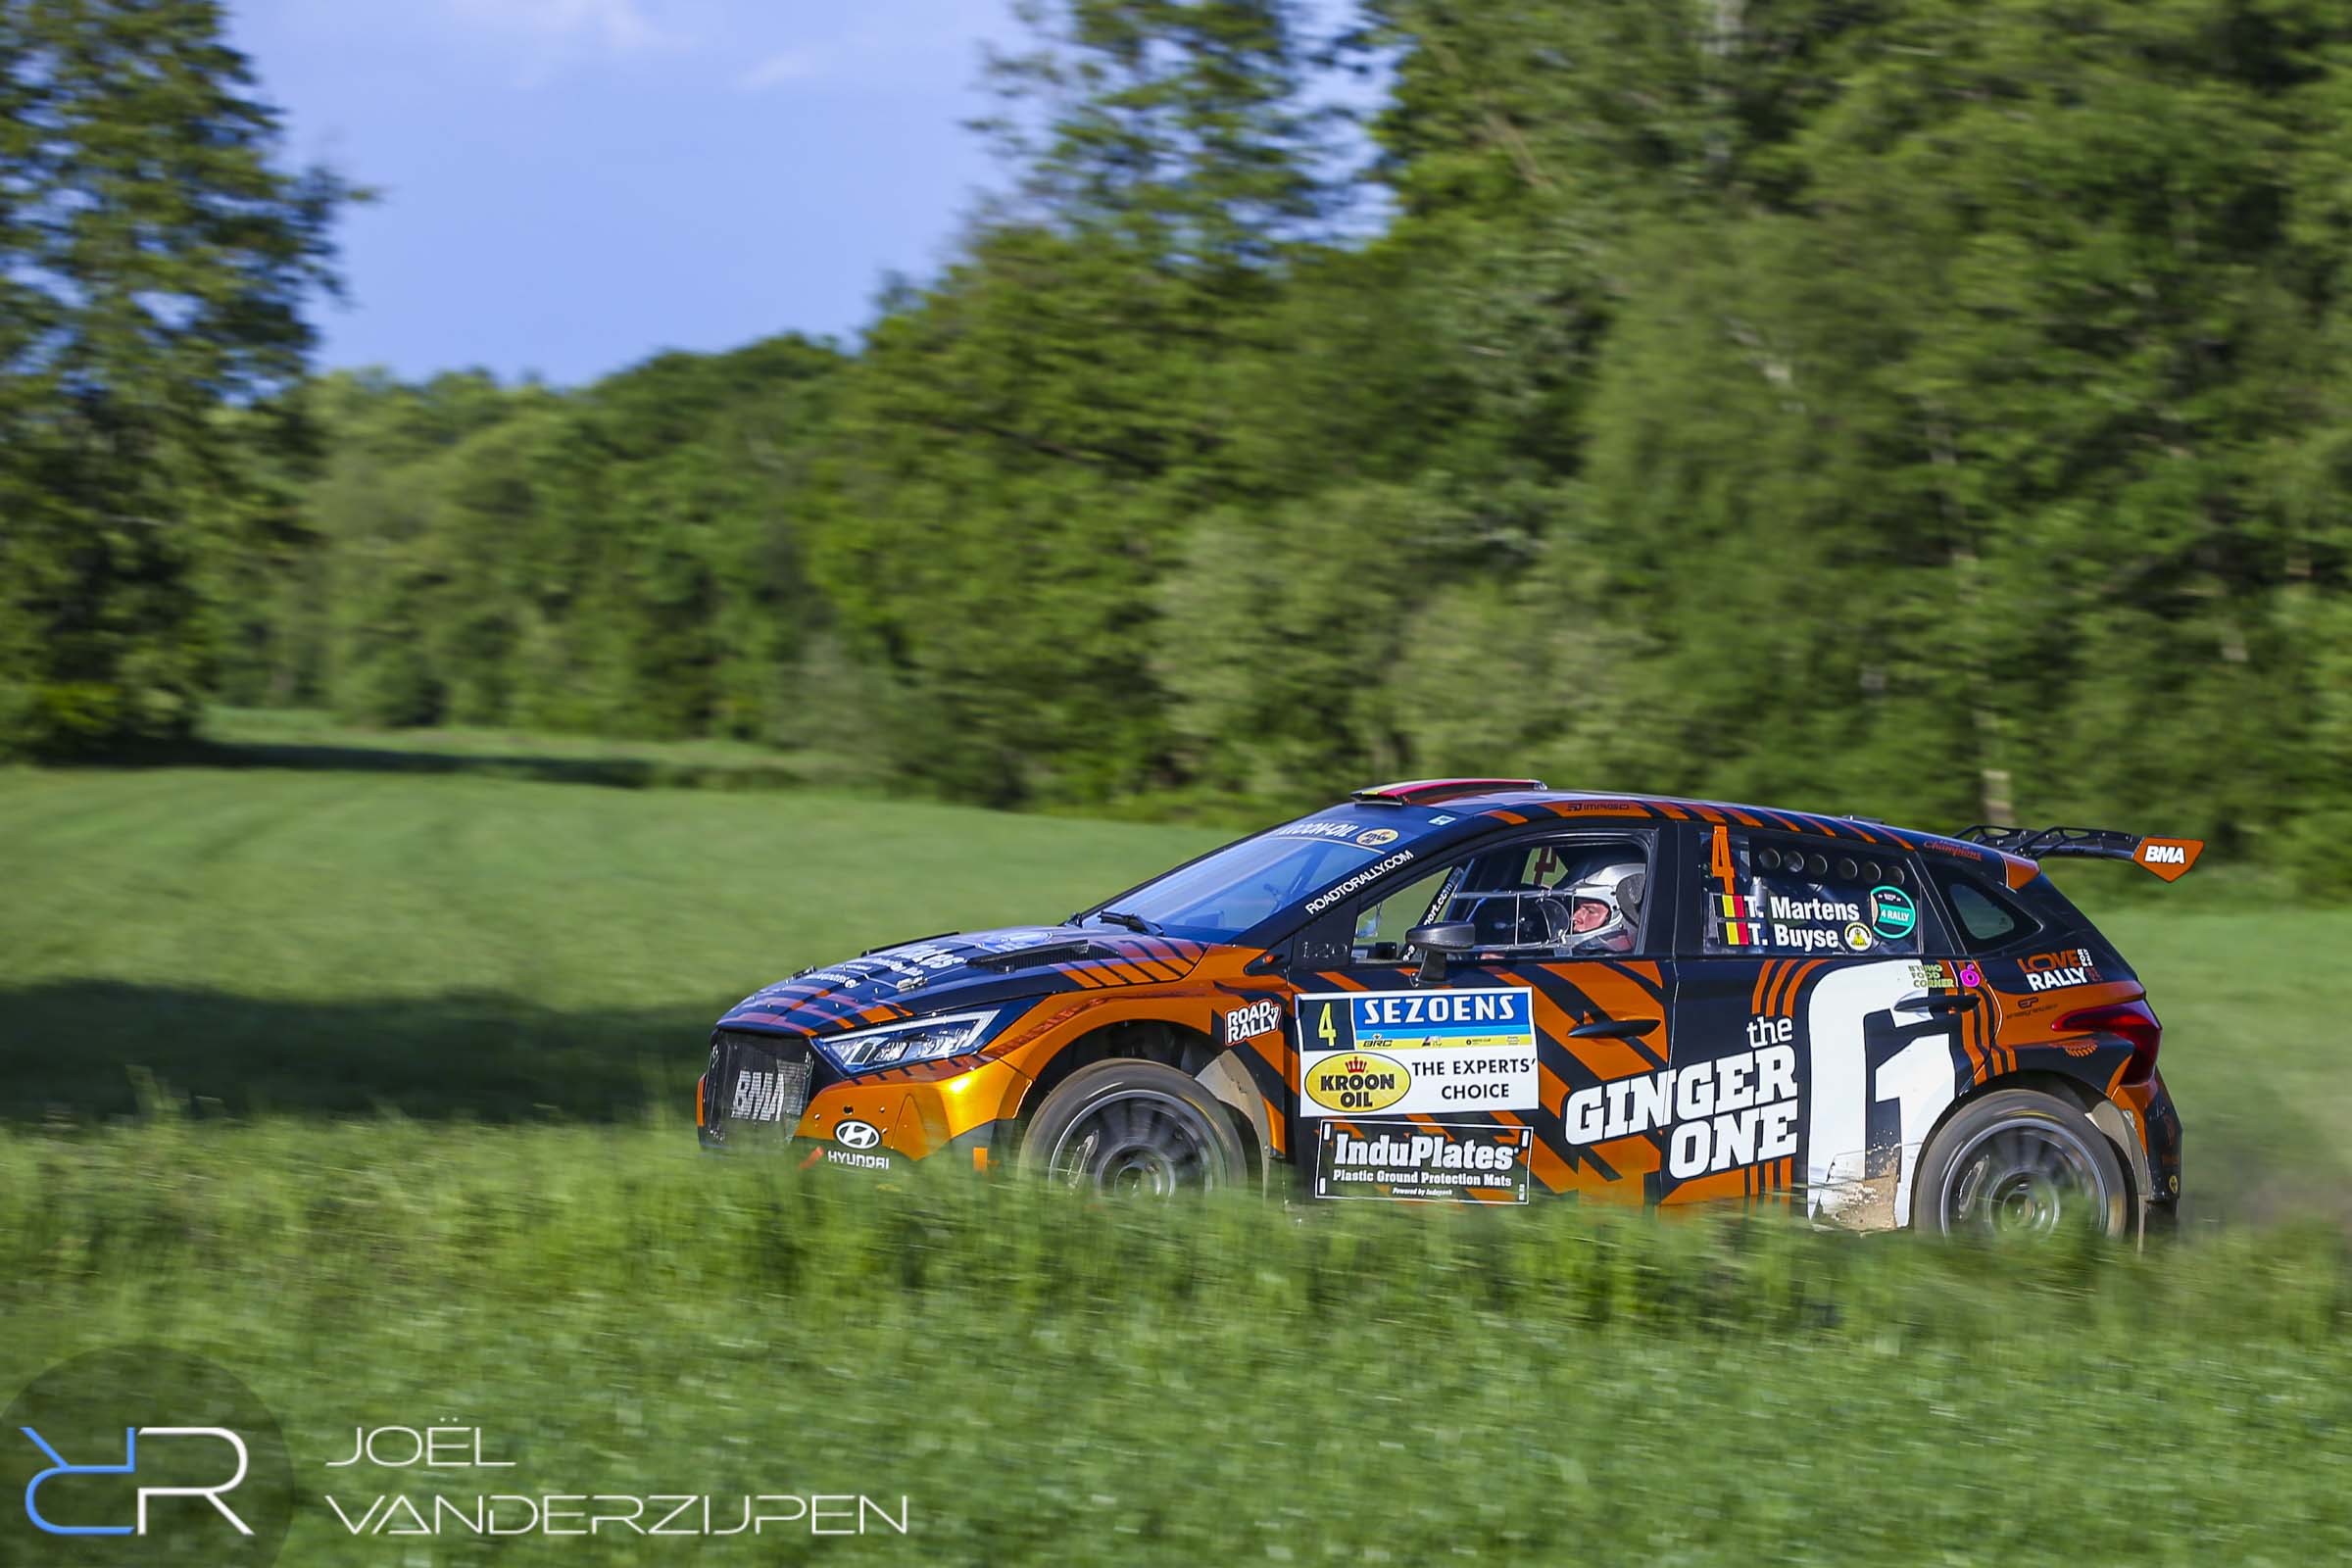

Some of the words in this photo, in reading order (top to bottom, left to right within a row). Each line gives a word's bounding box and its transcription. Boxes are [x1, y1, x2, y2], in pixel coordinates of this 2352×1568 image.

[1711, 825, 1736, 894] 4
[2144, 845, 2185, 864] BMA
[1305, 850, 1414, 915] ROADTORALLY.COM
[1744, 896, 1764, 918] T.
[1770, 896, 1860, 921] Martens
[1886, 909, 1910, 922] RALLY
[1748, 923, 1768, 947] T.
[1774, 923, 1838, 953] Buyse
[2017, 949, 2081, 973] LOVE
[1913, 978, 1954, 988] CORNER
[2026, 966, 2088, 992] RALLY
[1227, 1001, 1270, 1028] ROAD
[1270, 1005, 1279, 1014] TO
[1318, 1003, 1337, 1047] 4
[1364, 995, 1514, 1025] SEZOENS
[1227, 1013, 1278, 1044] RALLY
[1746, 1016, 1792, 1048] the
[1412, 1060, 1445, 1077] THE
[1453, 1057, 1536, 1075] EXPERTS'
[1320, 1074, 1396, 1092] KROON
[1442, 1083, 1509, 1100] CHOICE
[1565, 1045, 1798, 1146] GINGER
[1340, 1092, 1373, 1108] OIL
[1669, 1099, 1798, 1179] ONE
[828, 1151, 890, 1170] HYUNDAI
[1334, 1133, 1515, 1171] InduPlates
[1333, 1169, 1374, 1183] Plastic
[1377, 1171, 1419, 1185] Ground
[1421, 1172, 1481, 1187] Protection
[1484, 1174, 1512, 1188] Mats
[1393, 1187, 1418, 1196] Powered
